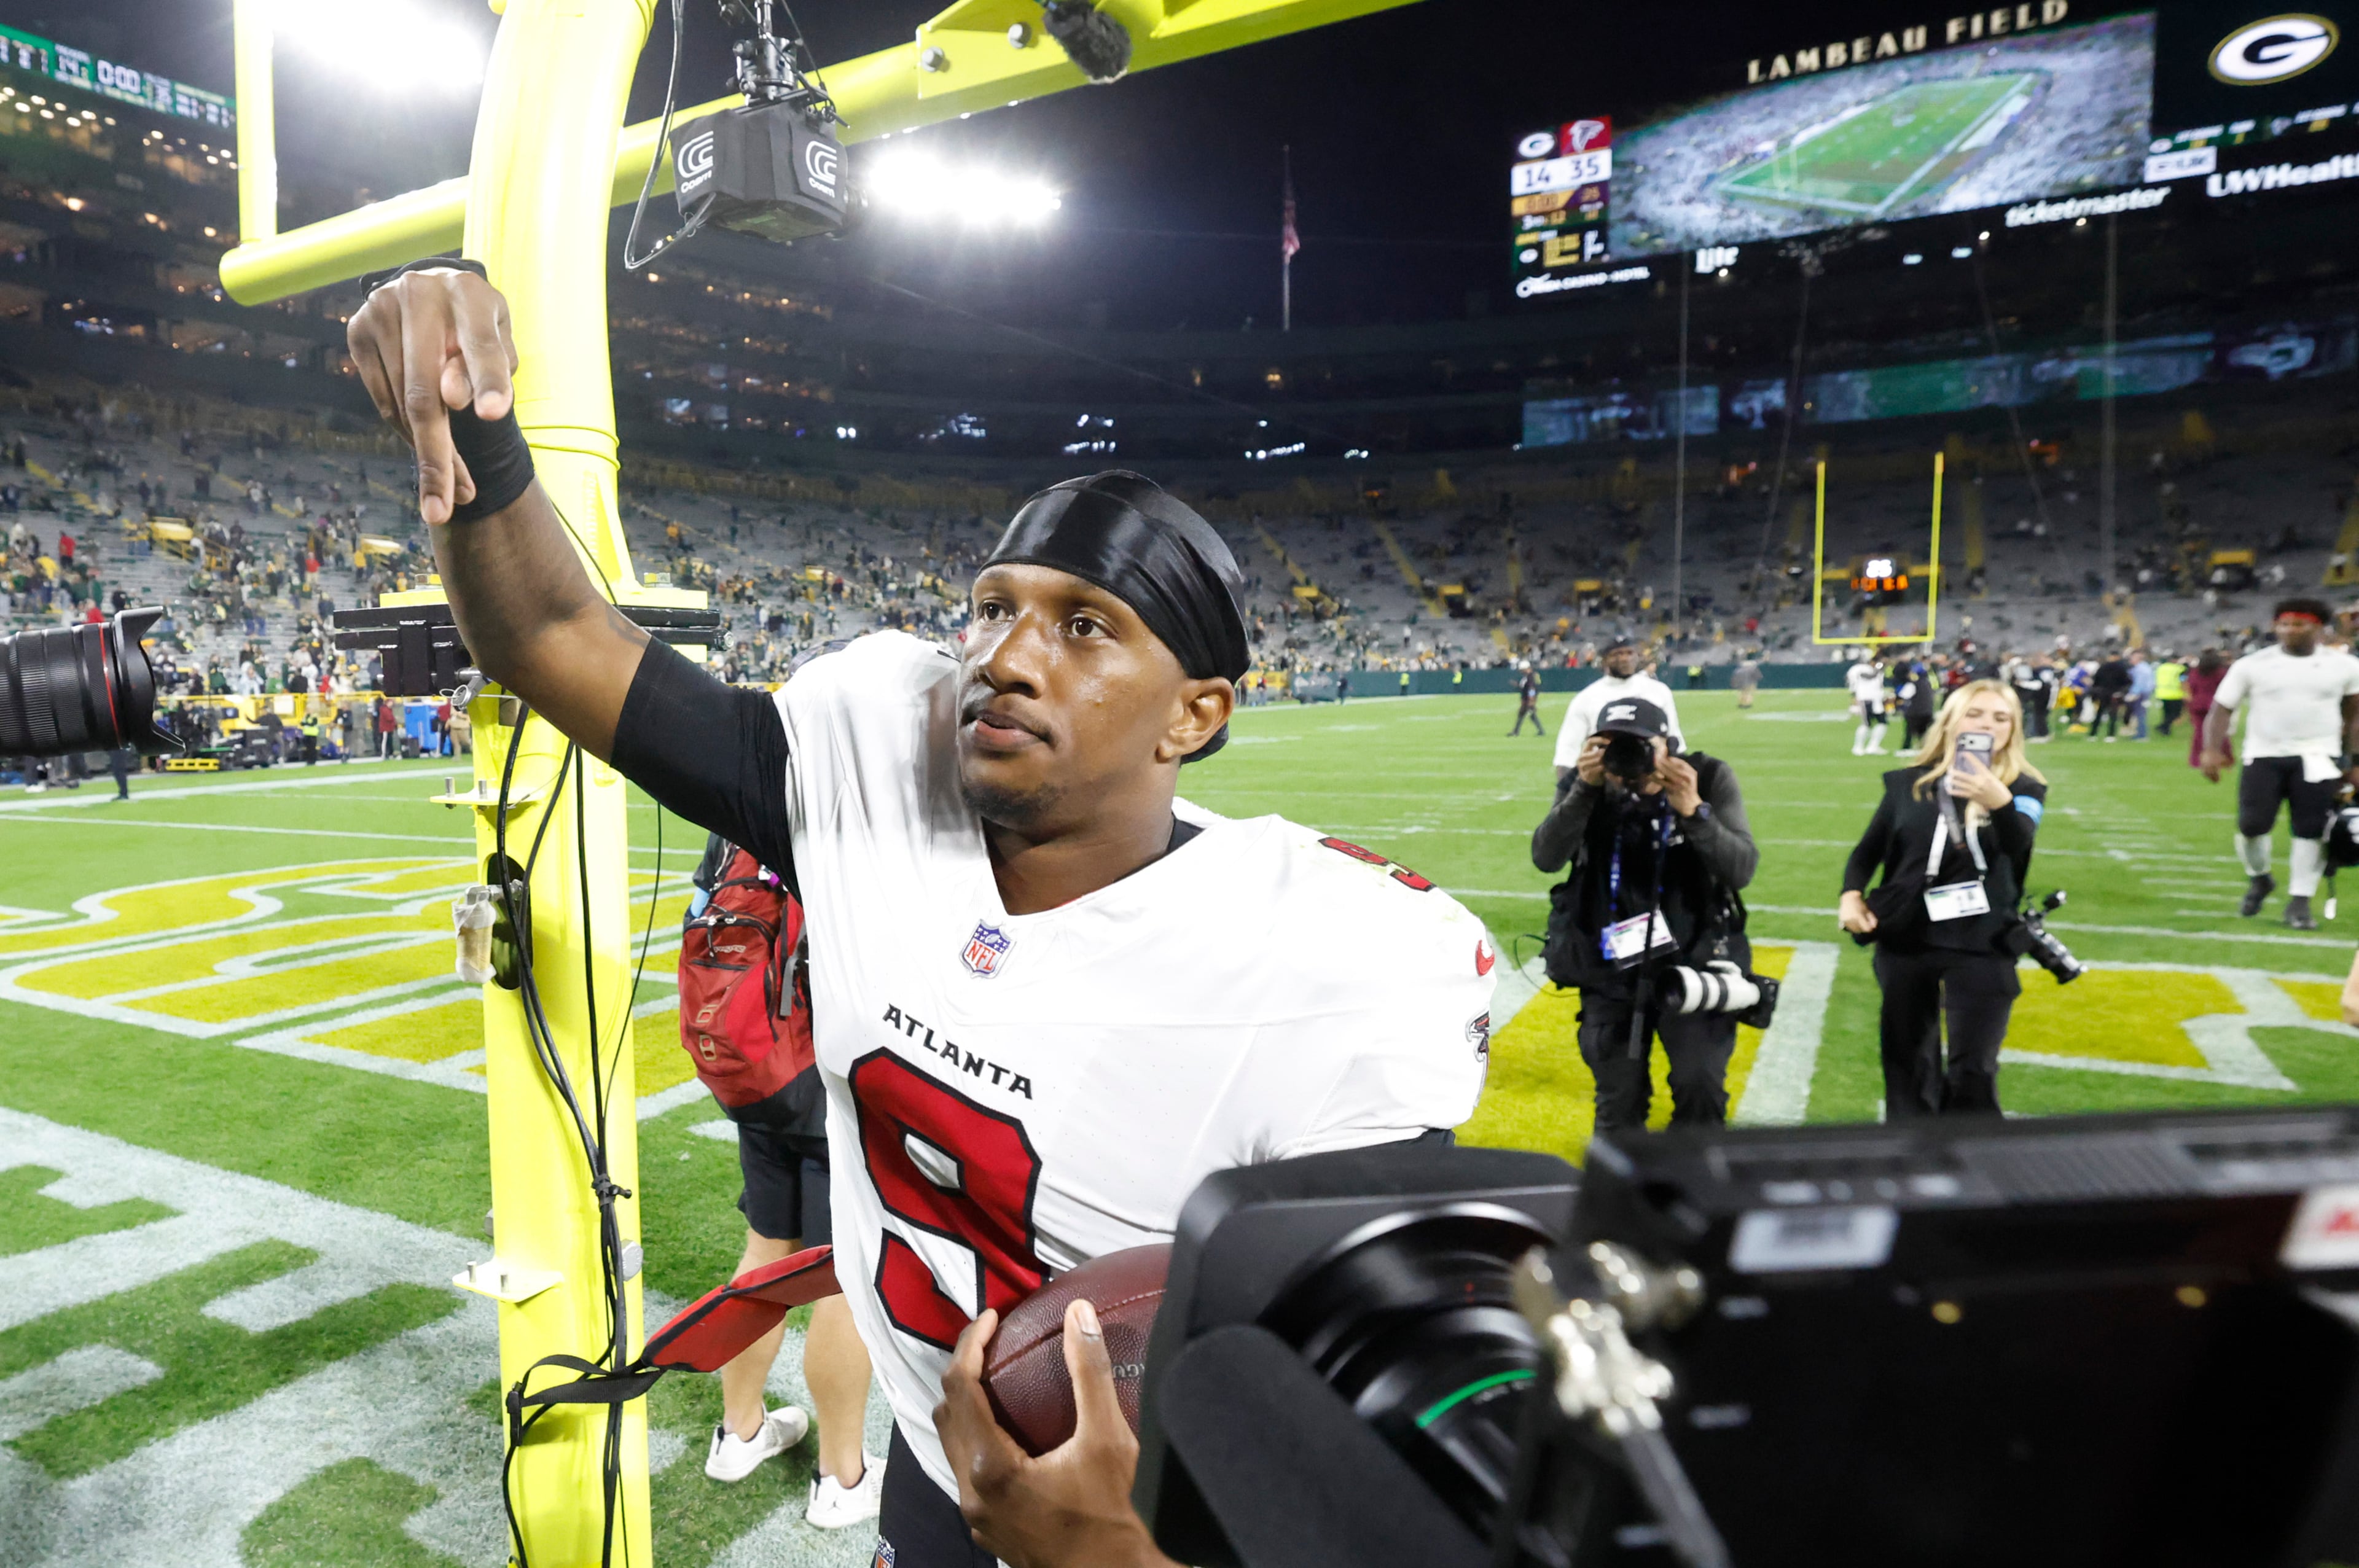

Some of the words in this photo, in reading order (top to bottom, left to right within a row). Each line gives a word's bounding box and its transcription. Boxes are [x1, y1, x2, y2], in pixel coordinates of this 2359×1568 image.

[1747, 24, 1928, 84] LAMBEAU
[1946, 0, 2069, 44] FIELD
[1525, 165, 1551, 188] 14
[1570, 157, 1600, 181] 35
[2207, 153, 2359, 198] UWHealt
[2005, 185, 2172, 228] ticketmaster
[966, 940, 997, 971] NFL
[882, 1002, 1033, 1101] ATLANTA
